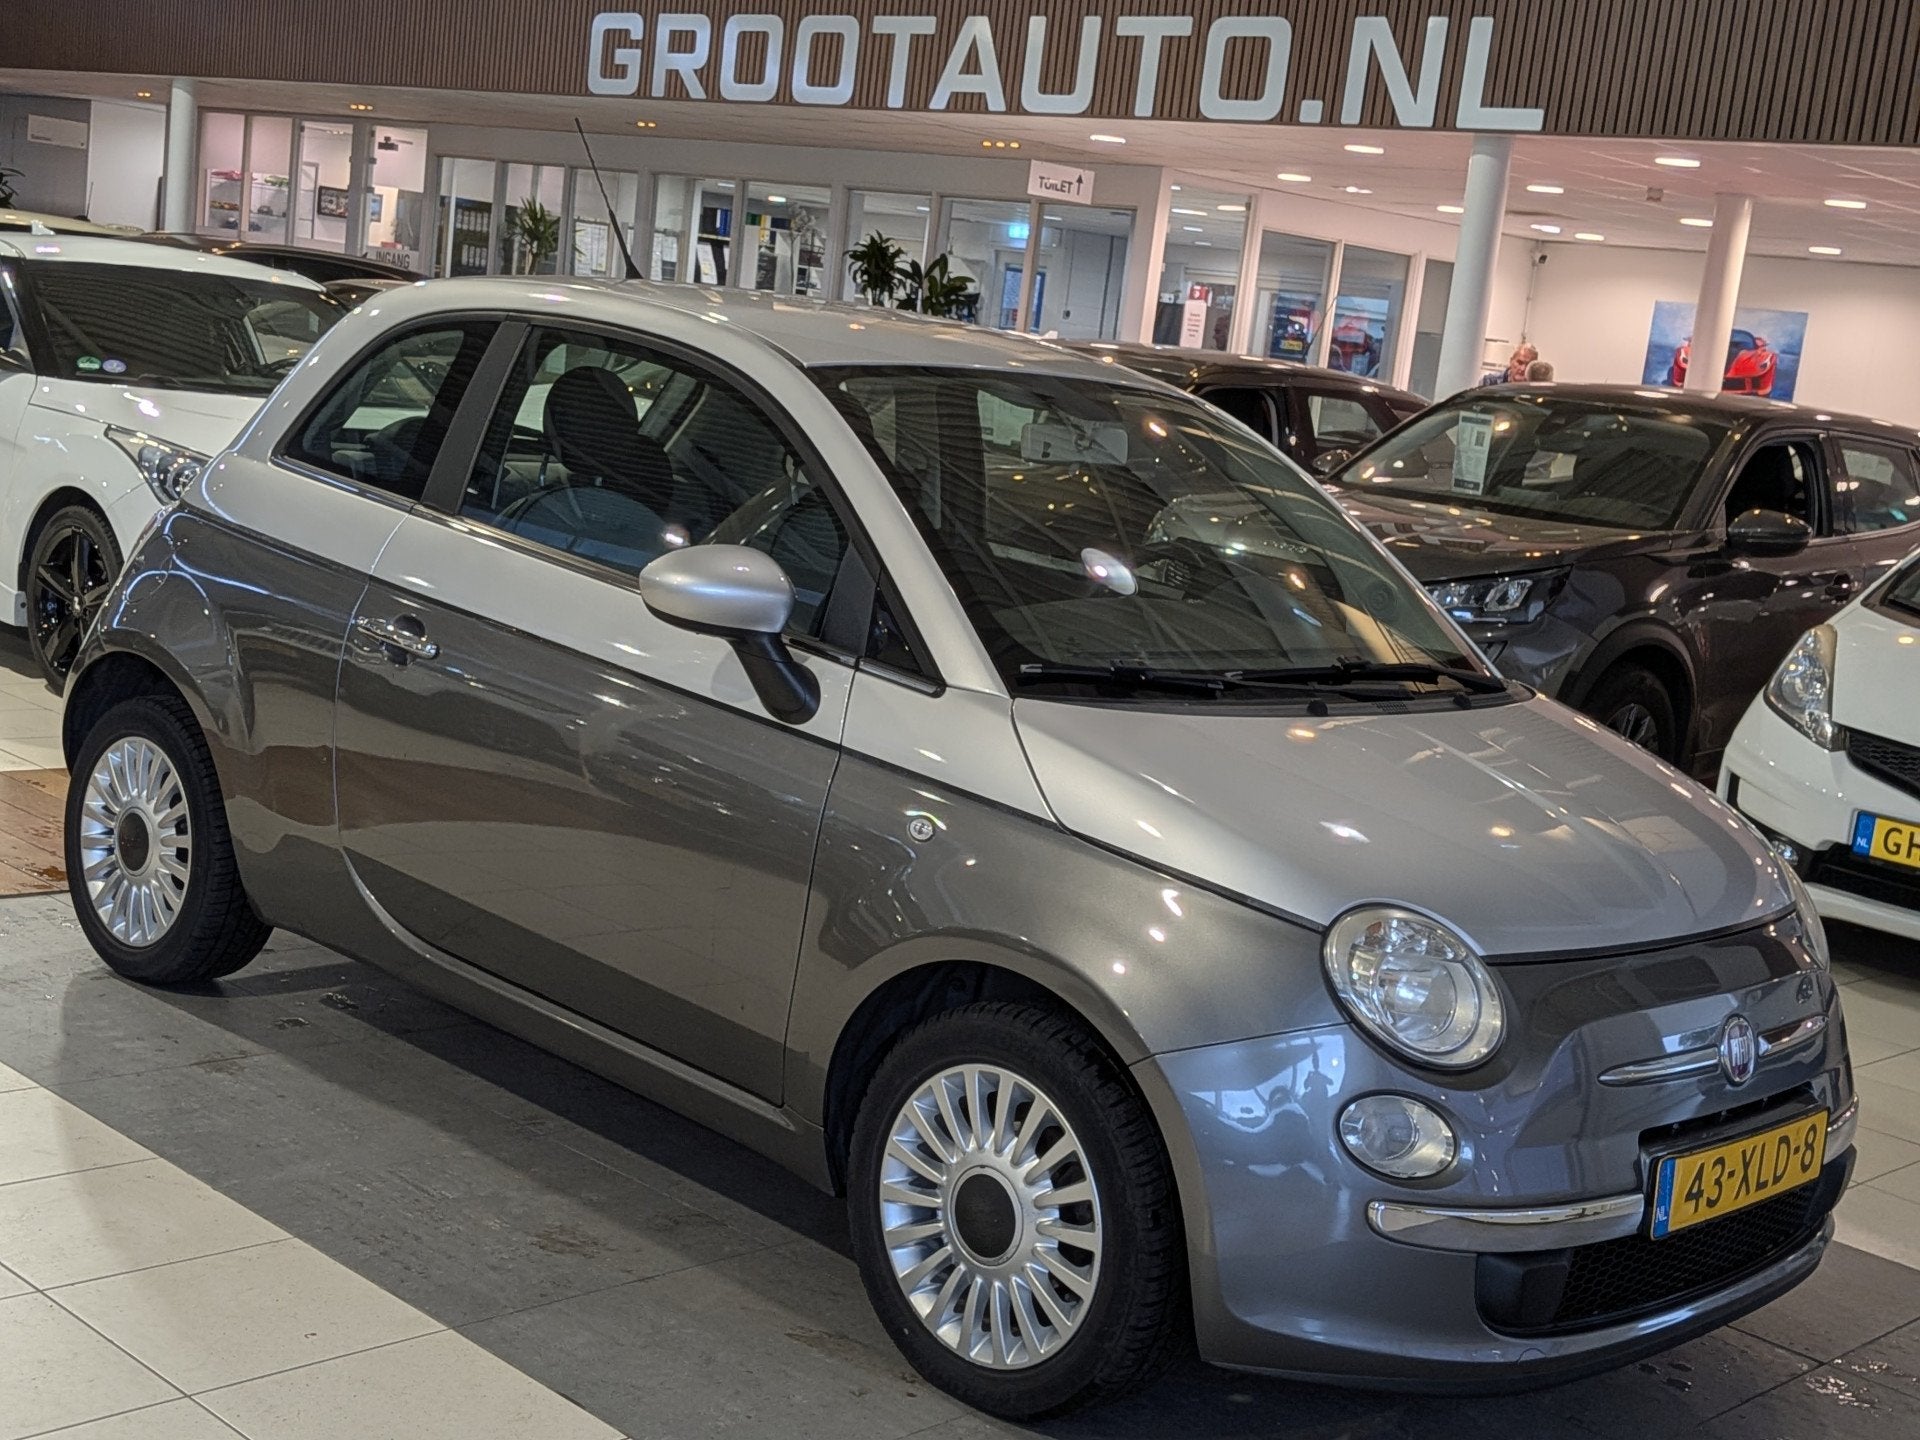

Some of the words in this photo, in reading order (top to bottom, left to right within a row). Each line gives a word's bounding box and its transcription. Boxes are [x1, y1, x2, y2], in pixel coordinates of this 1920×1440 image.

[588, 12, 1545, 131] GROOTAUTO.NL
[1039, 176, 1073, 194] TOILET
[376, 250, 410, 269] INGANG
[1856, 836, 1869, 849] NL
[1684, 1123, 1818, 1214] 43-XLD-8
